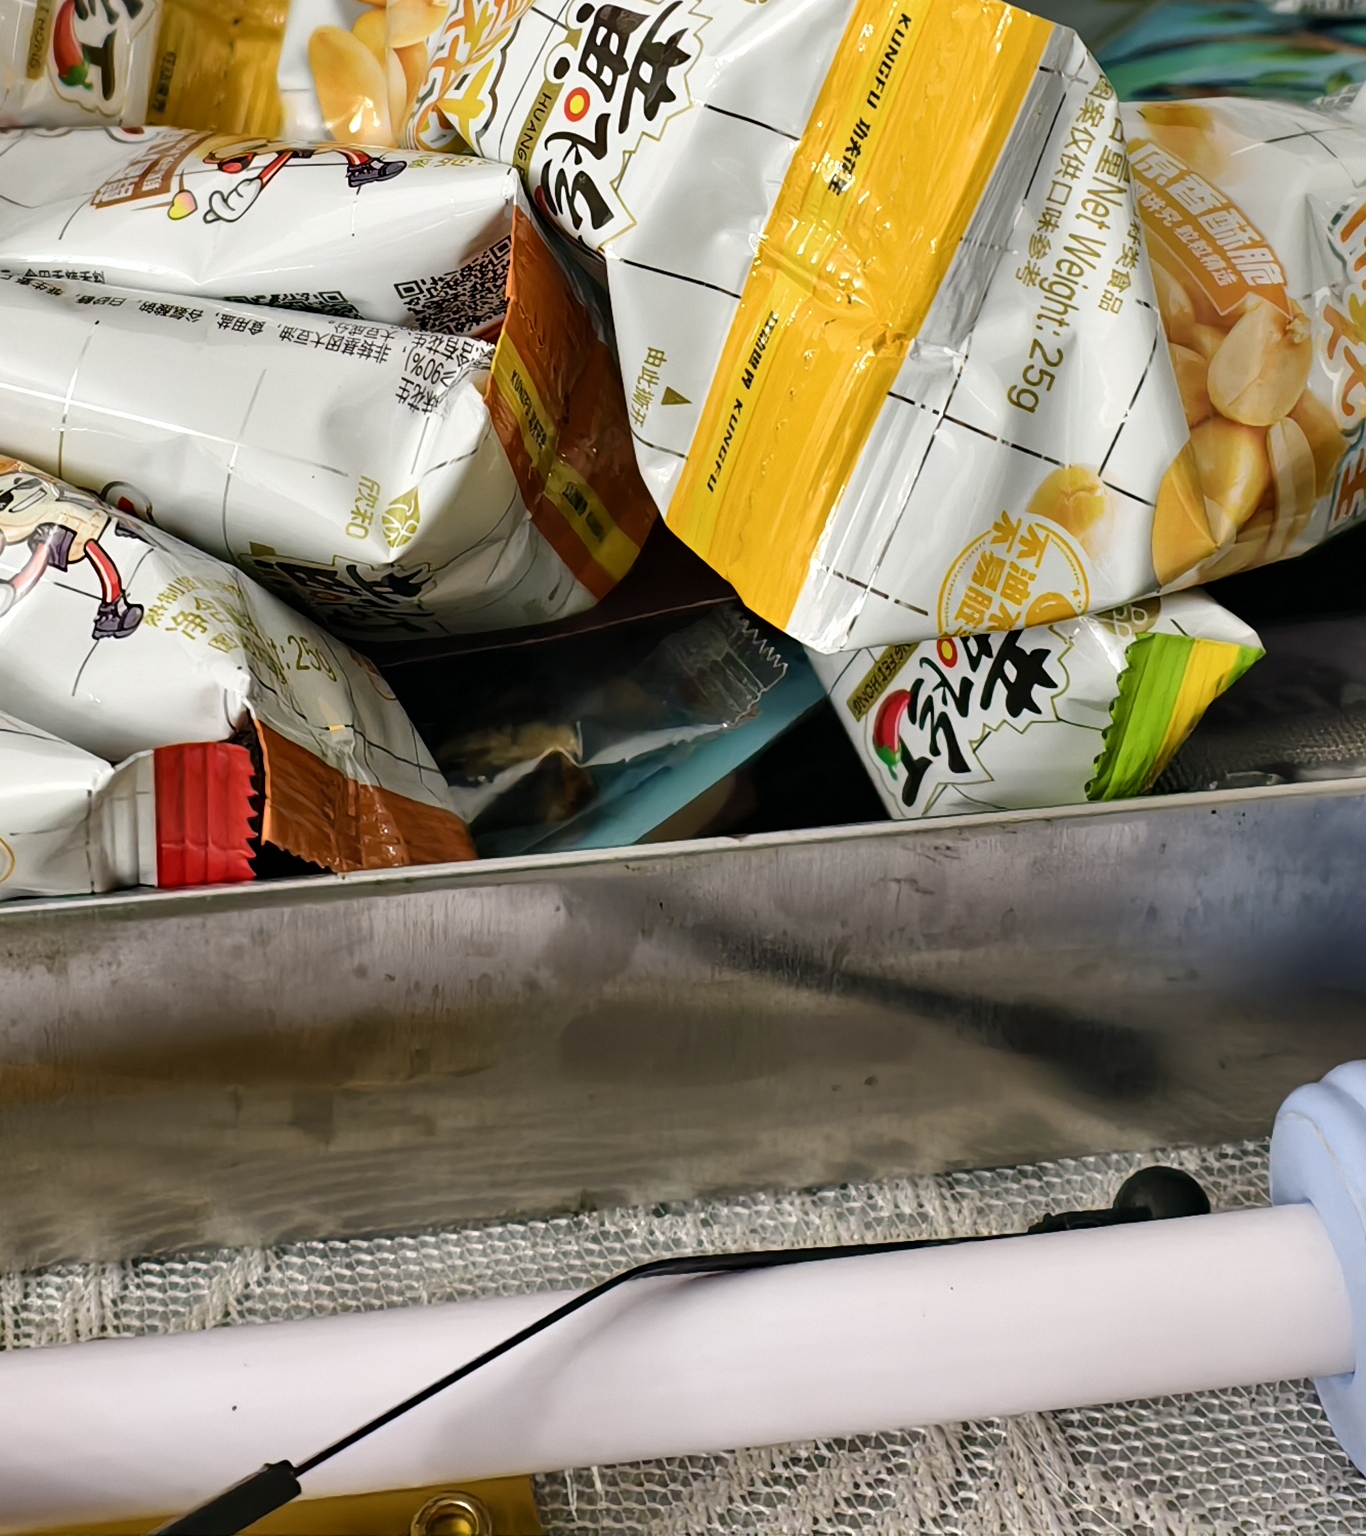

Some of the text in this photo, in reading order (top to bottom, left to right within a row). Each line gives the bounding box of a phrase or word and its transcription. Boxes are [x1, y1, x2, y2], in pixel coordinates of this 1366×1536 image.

[866, 13, 912, 111] KUNGFU
[514, 90, 554, 167] HUANG
[1015, 73, 1115, 288] 图案仅供口味参考
[1131, 144, 1285, 286] 原香酥脆
[1039, 224, 1103, 337] Weight:
[631, 346, 668, 428] 由此撕开
[1006, 336, 1065, 415] 25g
[705, 397, 746, 494] KUNGFU
[343, 473, 386, 541] 欣和
[852, 679, 880, 715] HONG
